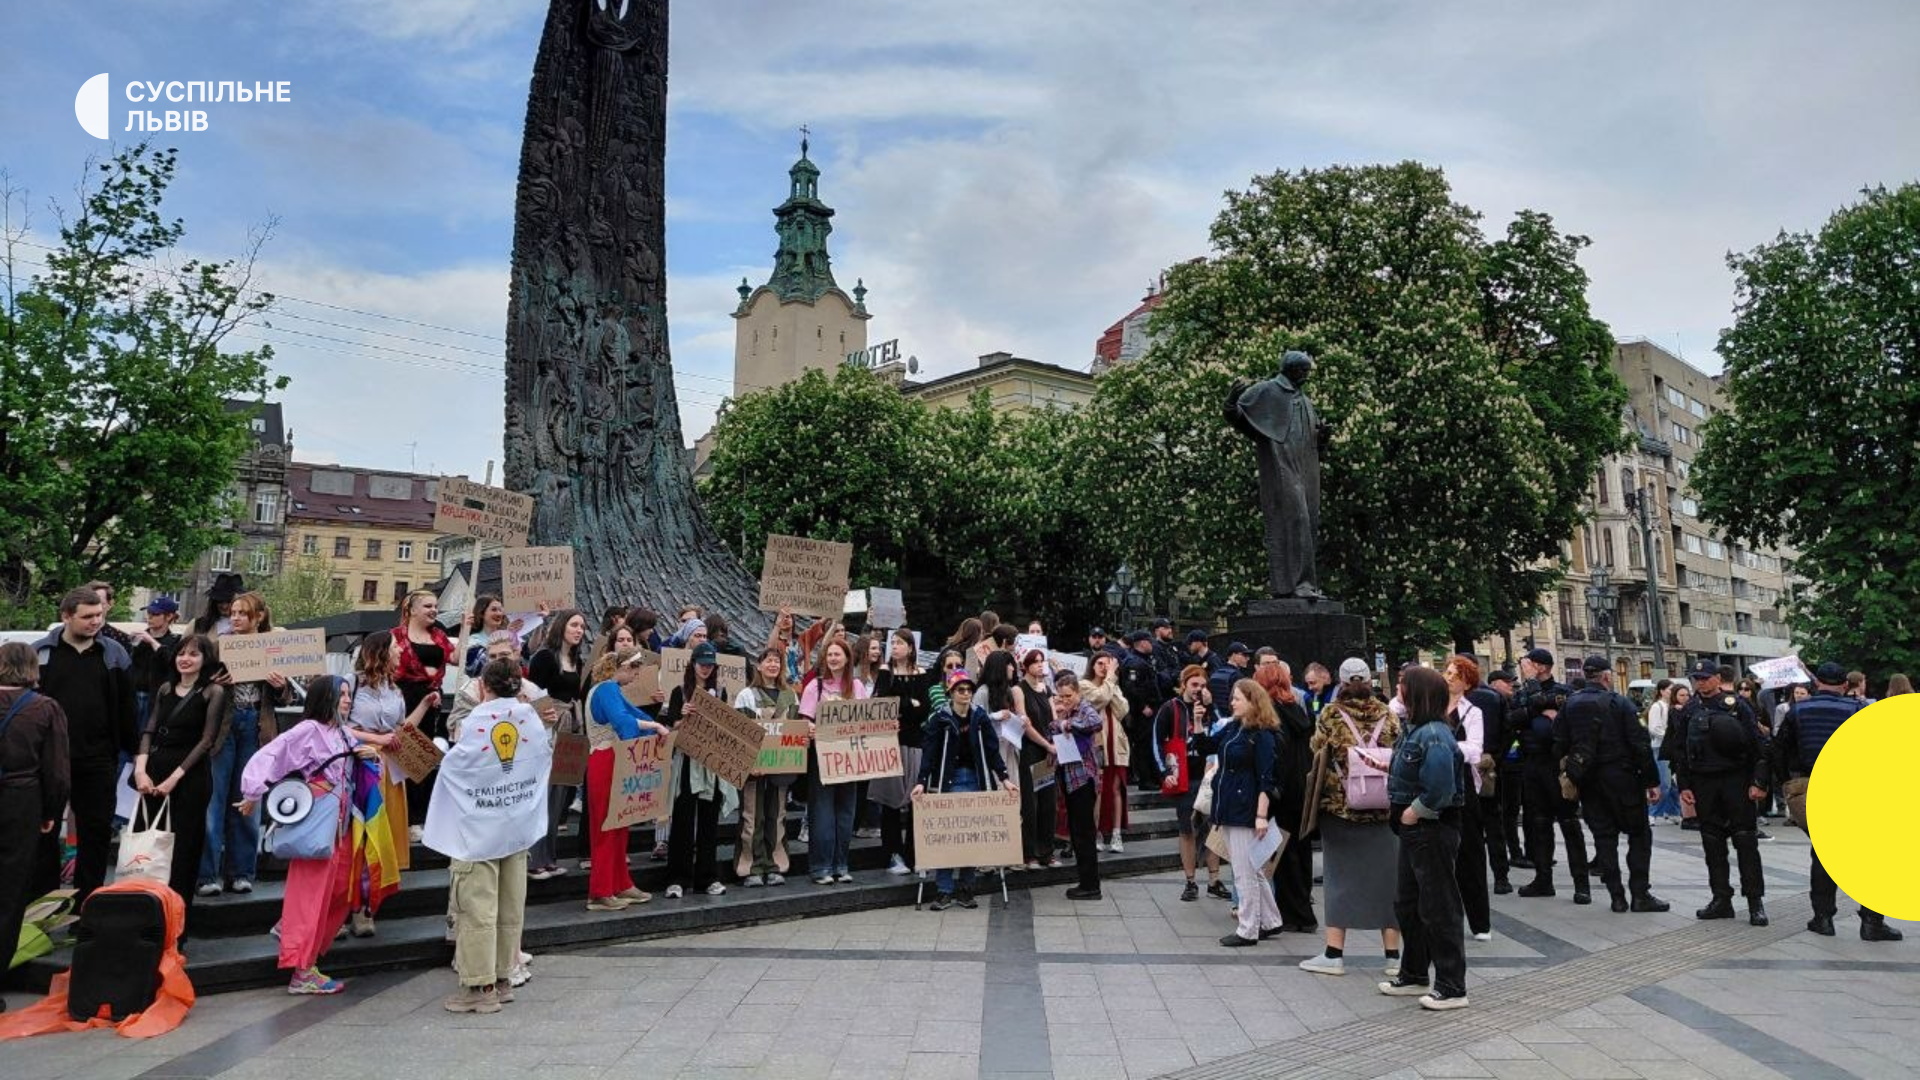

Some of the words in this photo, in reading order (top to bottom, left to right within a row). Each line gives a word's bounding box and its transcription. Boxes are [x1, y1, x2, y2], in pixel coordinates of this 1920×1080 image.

[846, 338, 901, 368] HOTEL
[508, 553, 544, 568] ХОЧЕТЕ
[548, 552, 570, 565] БУТИ
[820, 701, 898, 725] НАСИЛЬСТВО
[850, 735, 869, 751] НЕ
[822, 747, 900, 776] ТРАДИЦІЯ
